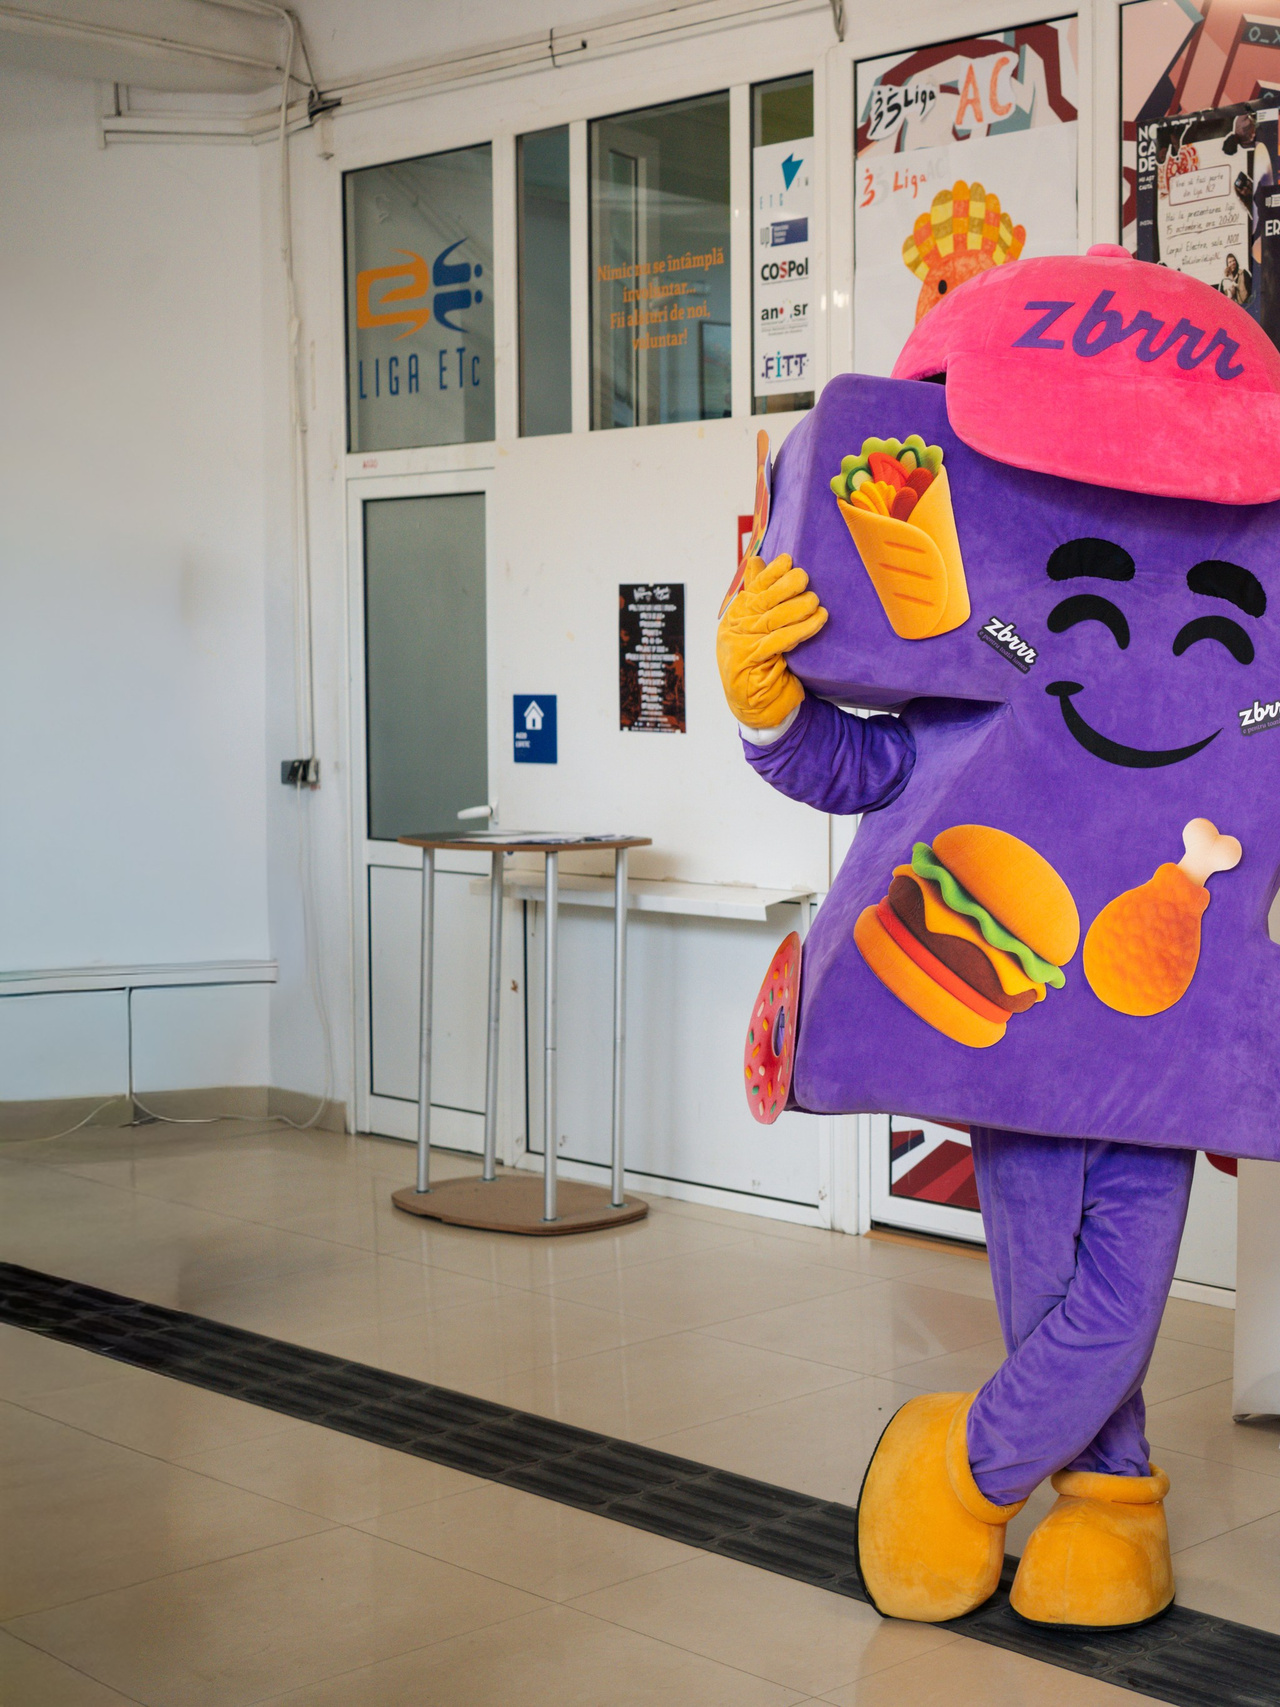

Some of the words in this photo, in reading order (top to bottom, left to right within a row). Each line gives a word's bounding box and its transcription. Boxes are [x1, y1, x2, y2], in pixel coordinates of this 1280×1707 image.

[955, 56, 1013, 125] AC
[597, 261, 632, 281] Nimic
[653, 260, 666, 274] se
[667, 247, 725, 272] întâmplă
[761, 257, 809, 281] COSPol
[610, 312, 625, 329] Fii
[670, 303, 685, 321] de
[687, 299, 711, 319] noi,
[632, 327, 688, 350] voluntar!
[1012, 289, 1244, 381] zbrrr
[358, 353, 420, 399] LIGA
[984, 617, 1037, 664] zbrrr
